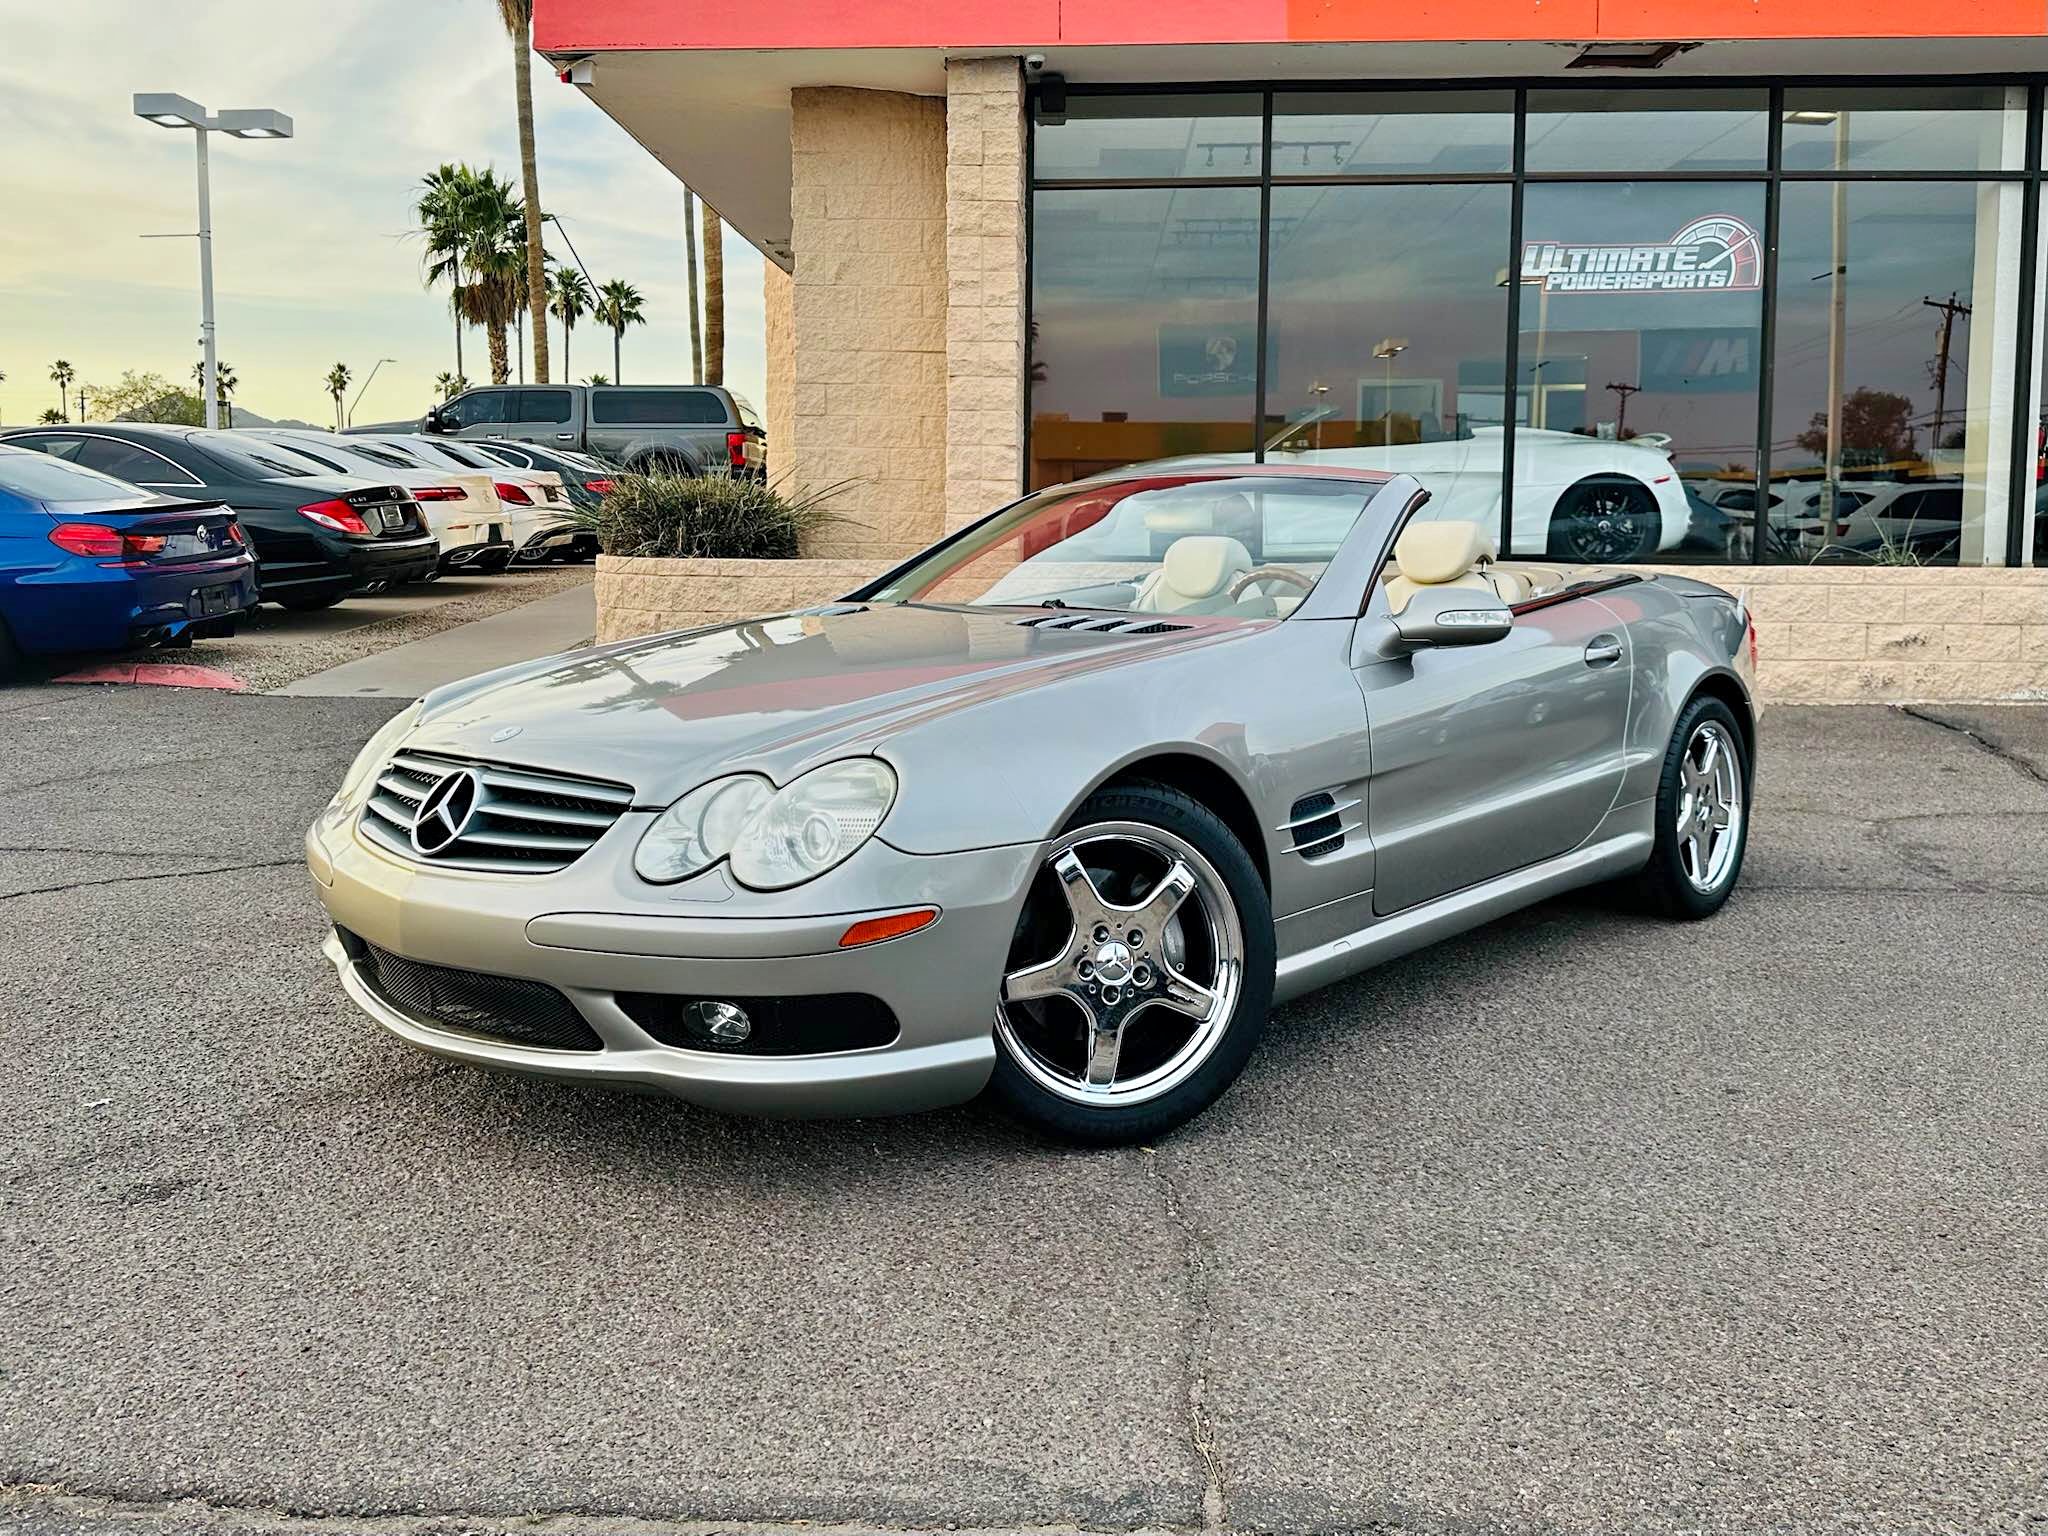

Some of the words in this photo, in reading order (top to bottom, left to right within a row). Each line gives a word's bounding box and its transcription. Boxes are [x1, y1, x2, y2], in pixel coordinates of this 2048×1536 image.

[1522, 245, 1701, 276] ULTIMATE
[1546, 271, 1728, 291] POWERSPORTS
[1174, 373, 1257, 385] PORSCH
